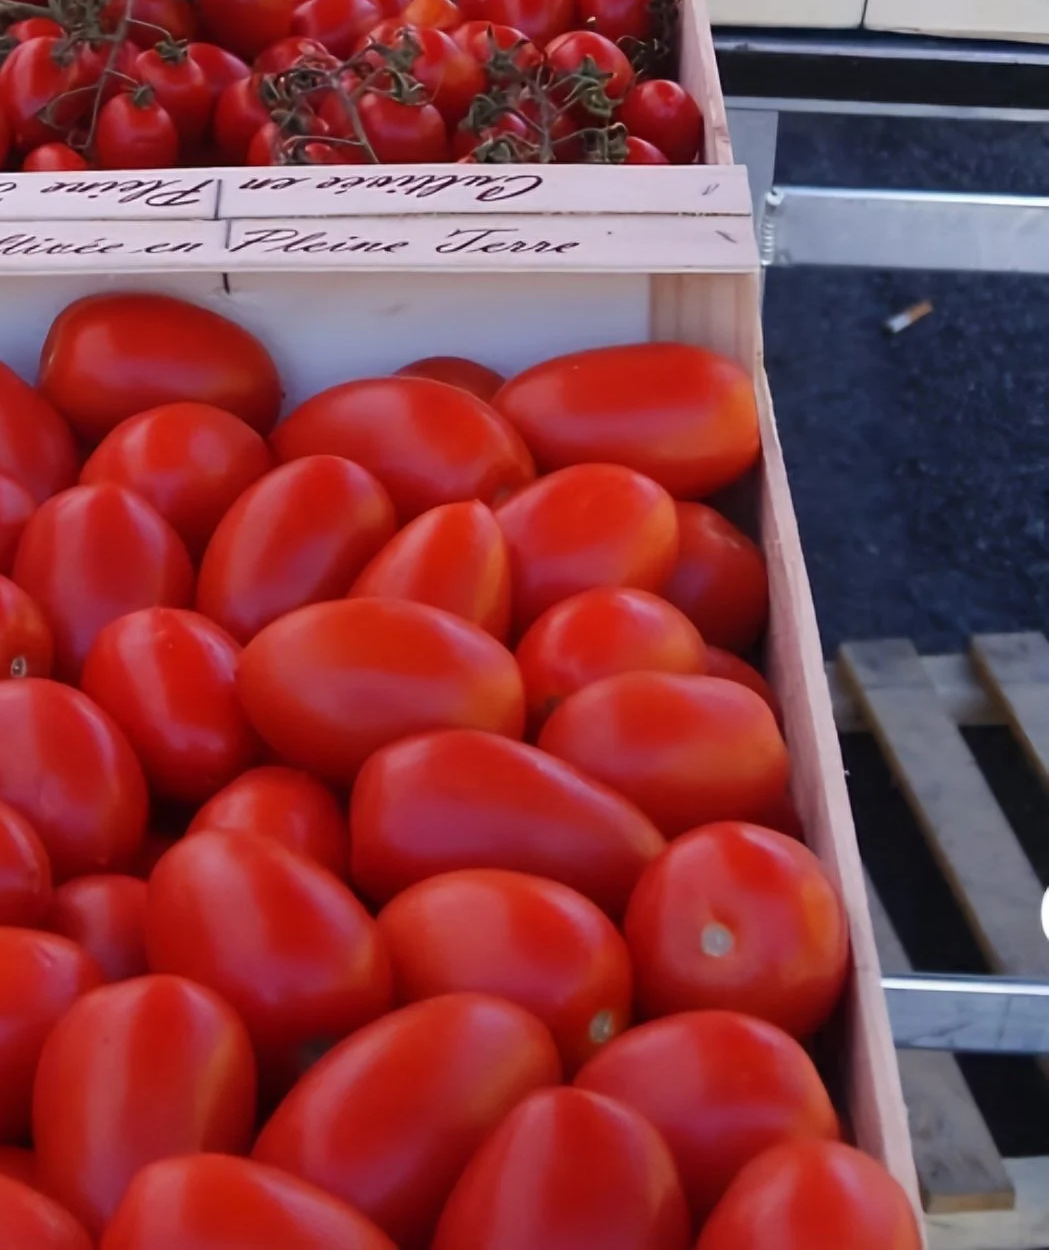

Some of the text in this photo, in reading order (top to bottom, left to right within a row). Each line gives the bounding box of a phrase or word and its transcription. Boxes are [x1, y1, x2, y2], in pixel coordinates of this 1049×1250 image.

[40, 178, 215, 208] Pleine
[238, 176, 310, 191] en
[318, 174, 544, 203] Cultivée
[127, 241, 205, 256] en
[229, 228, 410, 255] Pleine
[435, 227, 582, 255] Terre
